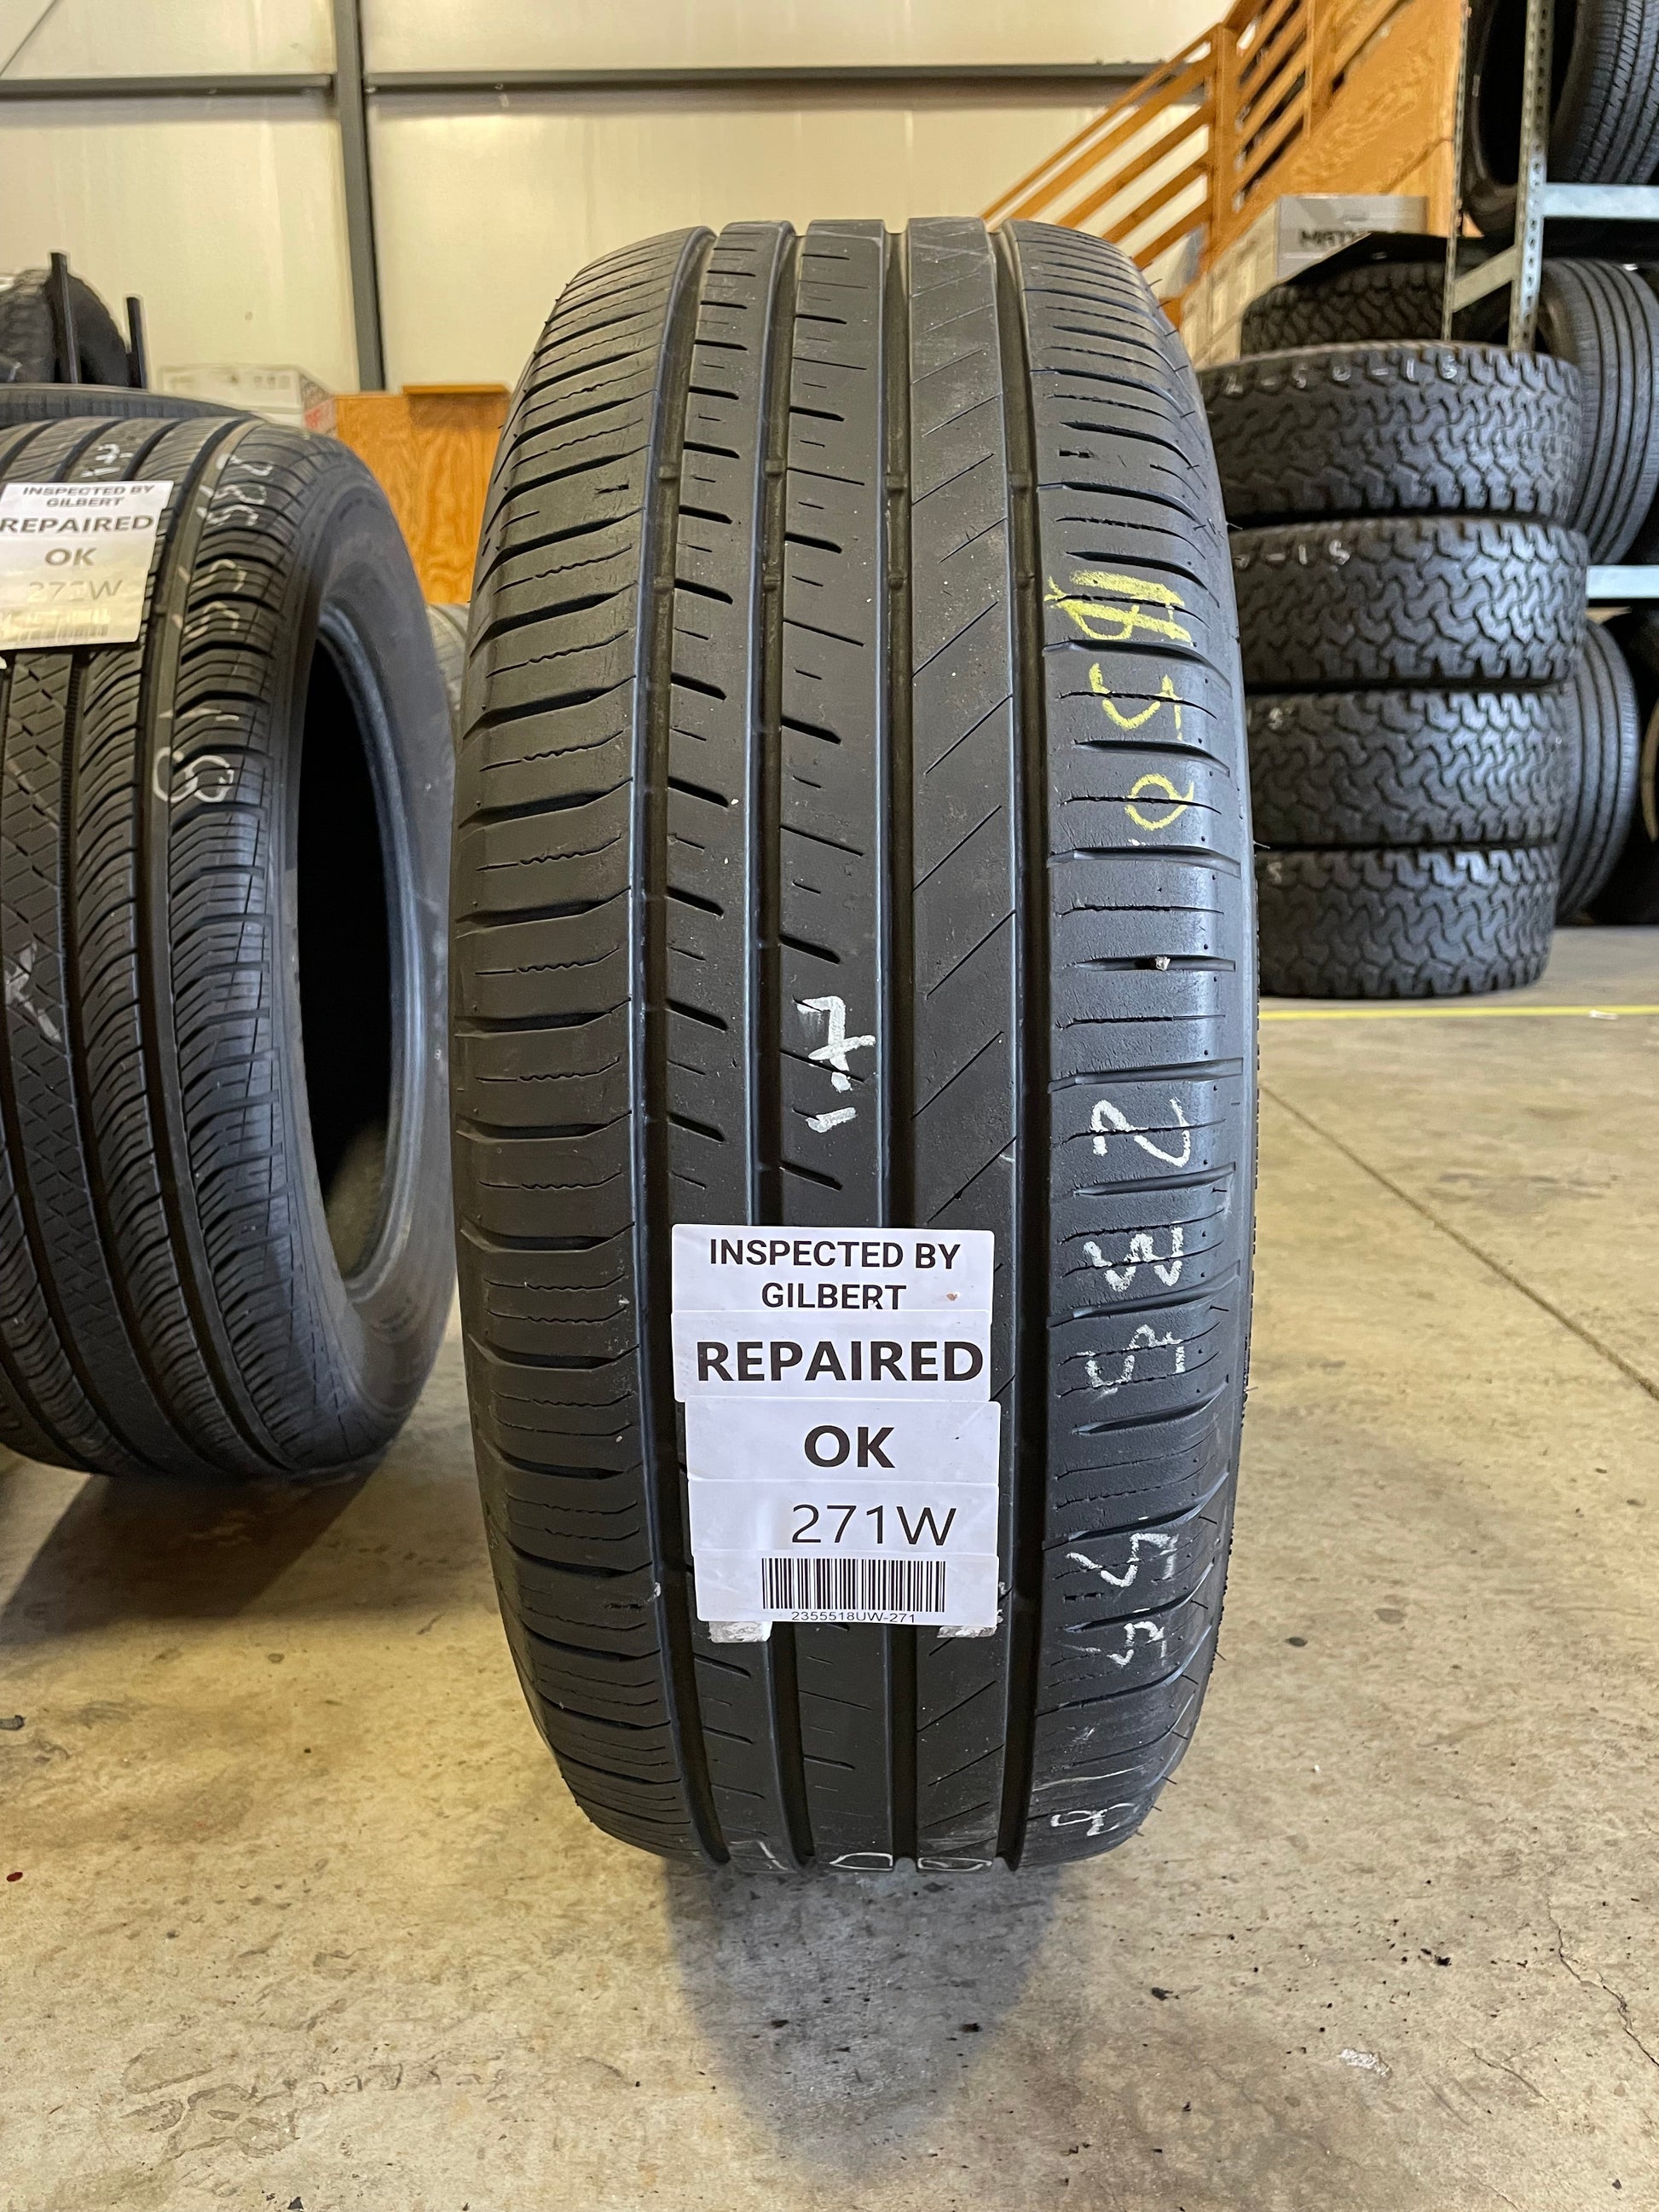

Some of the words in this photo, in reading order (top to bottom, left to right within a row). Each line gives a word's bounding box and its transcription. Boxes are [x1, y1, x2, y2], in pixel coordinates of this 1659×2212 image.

[23, 486, 126, 496] INSPECTED
[130, 484, 155, 494] BY
[46, 497, 125, 508] GILBERT
[0, 514, 154, 534] REPAIRED
[44, 547, 97, 567] OK
[709, 1239, 904, 1268] INSPECTED
[915, 1244, 962, 1270] BY
[1083, 1099, 1192, 1398] 235
[761, 1283, 907, 1310] GILBERT
[697, 1341, 983, 1382] REPAIRED
[804, 1425, 895, 1469] OK
[792, 1504, 957, 1546] 271W
[791, 1611, 916, 1624] 2355518UW-271
